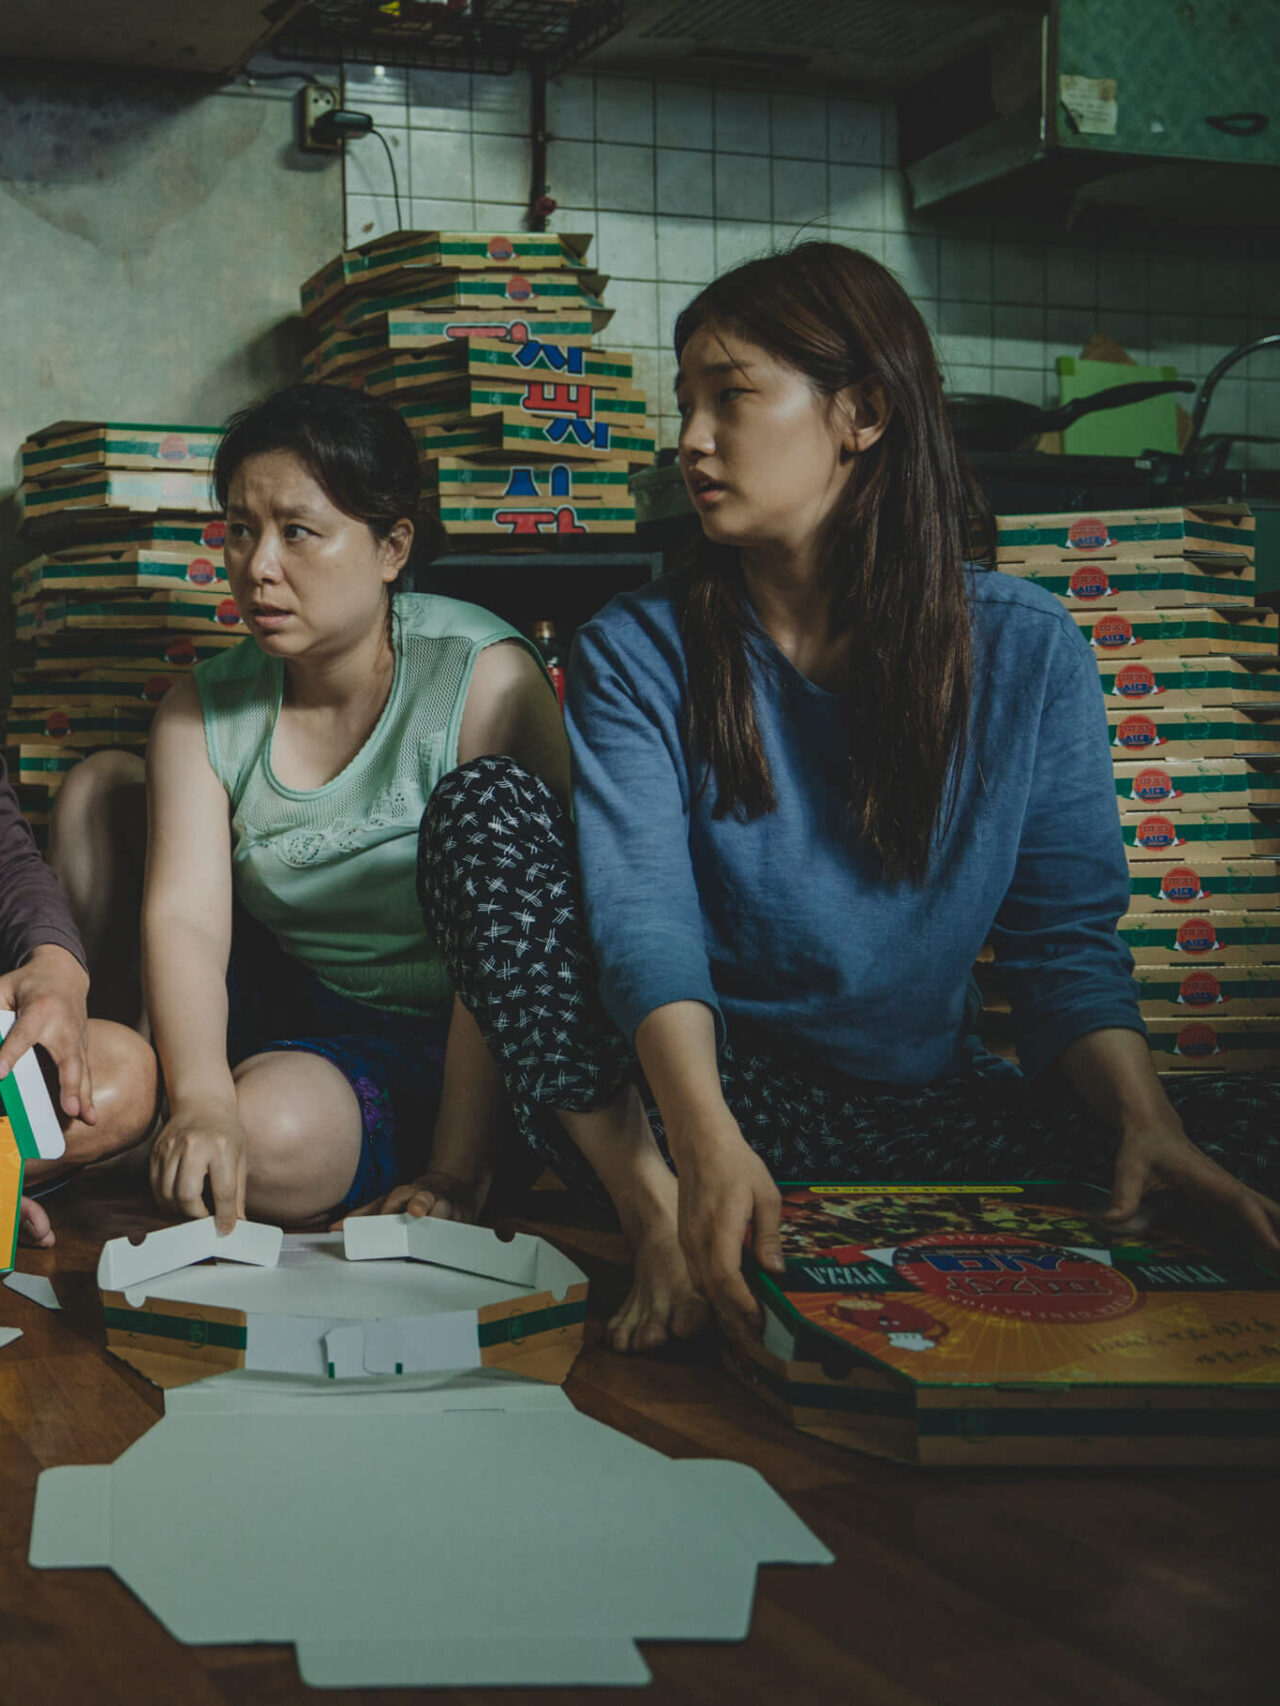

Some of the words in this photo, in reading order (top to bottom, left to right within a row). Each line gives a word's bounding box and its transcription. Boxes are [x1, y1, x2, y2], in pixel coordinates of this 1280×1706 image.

[922, 1253, 1065, 1272] 시대
[801, 1266, 888, 1284] PIZZA
[1136, 1265, 1228, 1284] ITALY
